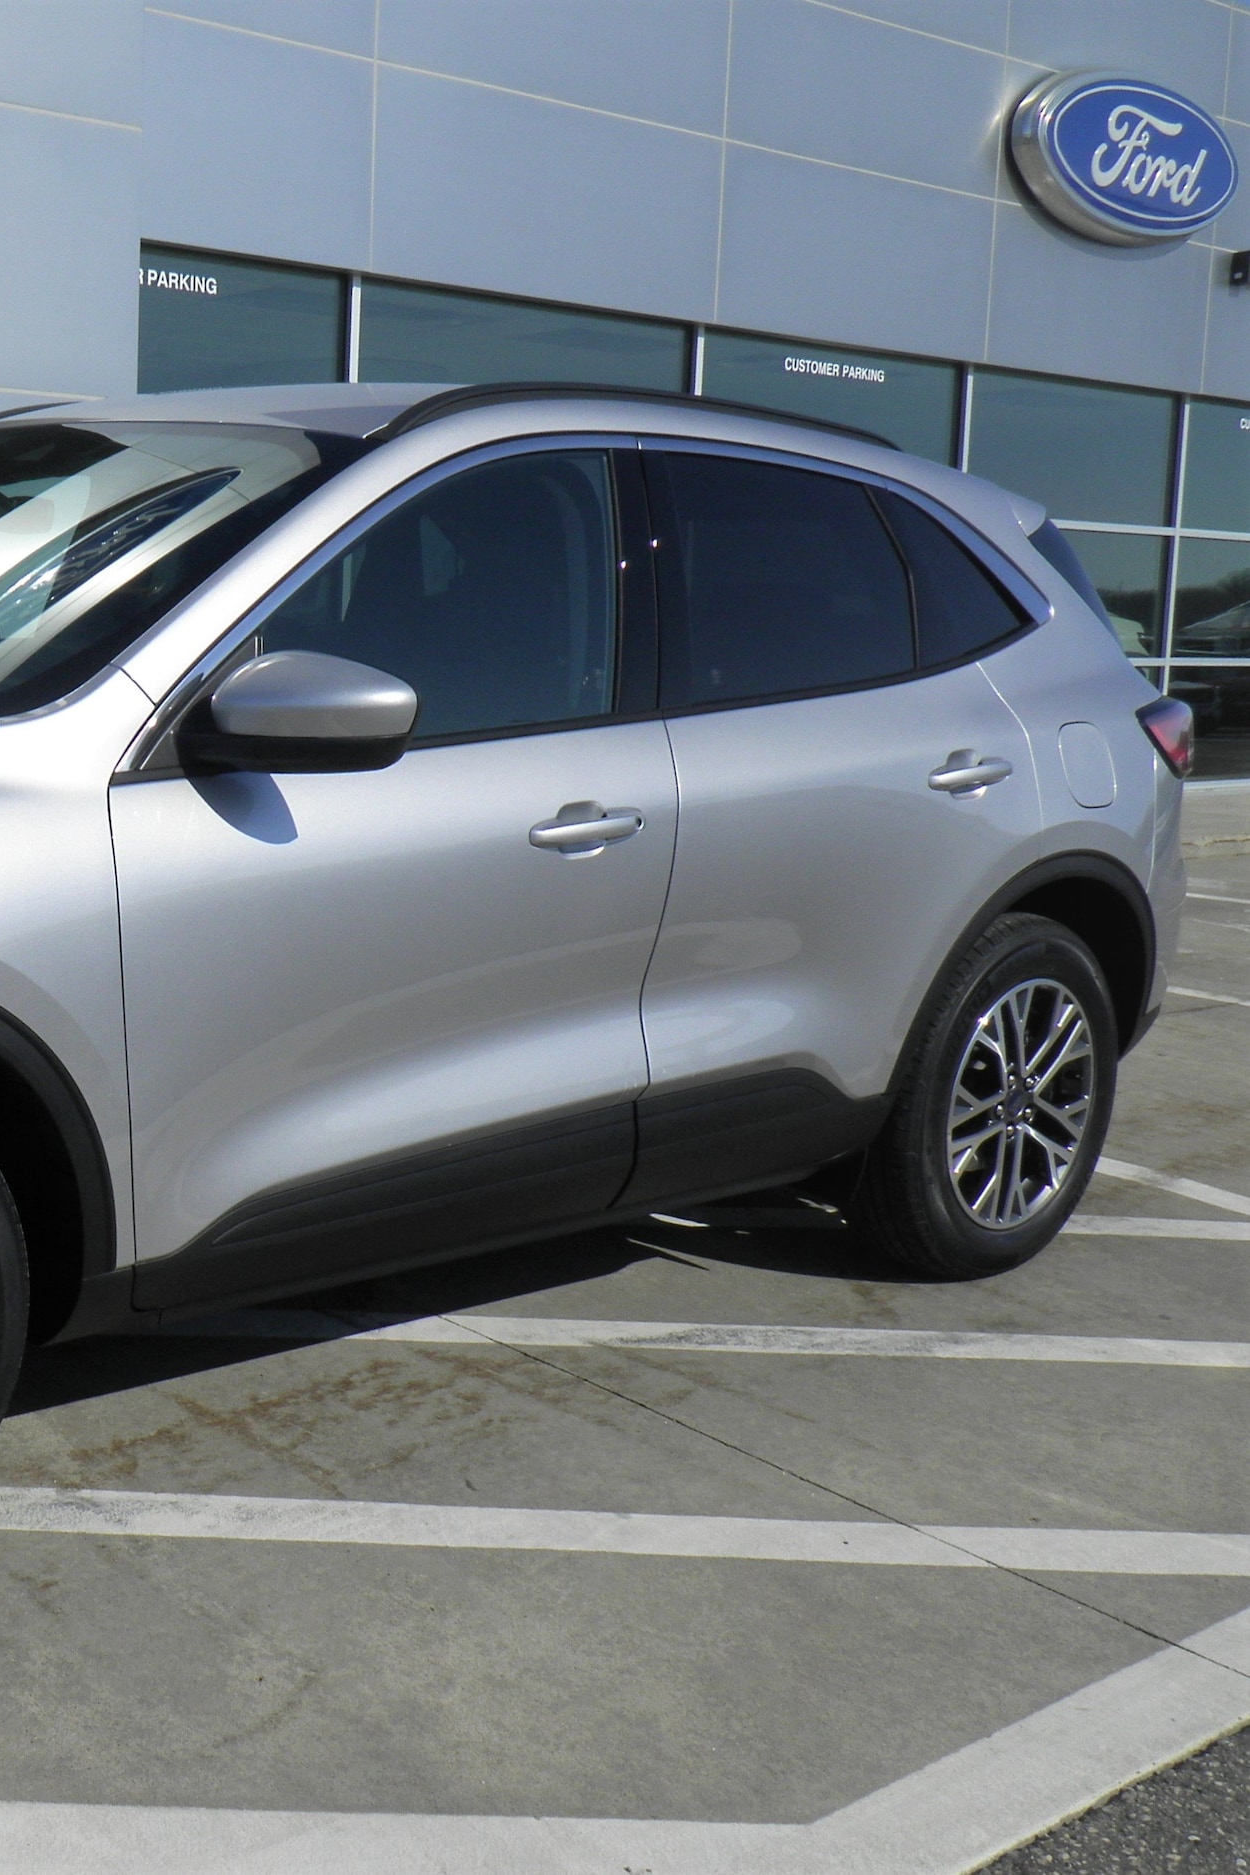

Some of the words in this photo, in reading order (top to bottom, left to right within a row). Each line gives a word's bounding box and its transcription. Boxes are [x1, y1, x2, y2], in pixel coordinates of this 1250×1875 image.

[1091, 104, 1207, 206] Ford
[147, 269, 217, 294] PARKING
[784, 357, 840, 377] CUSTOMER
[841, 364, 885, 383] PARKING
